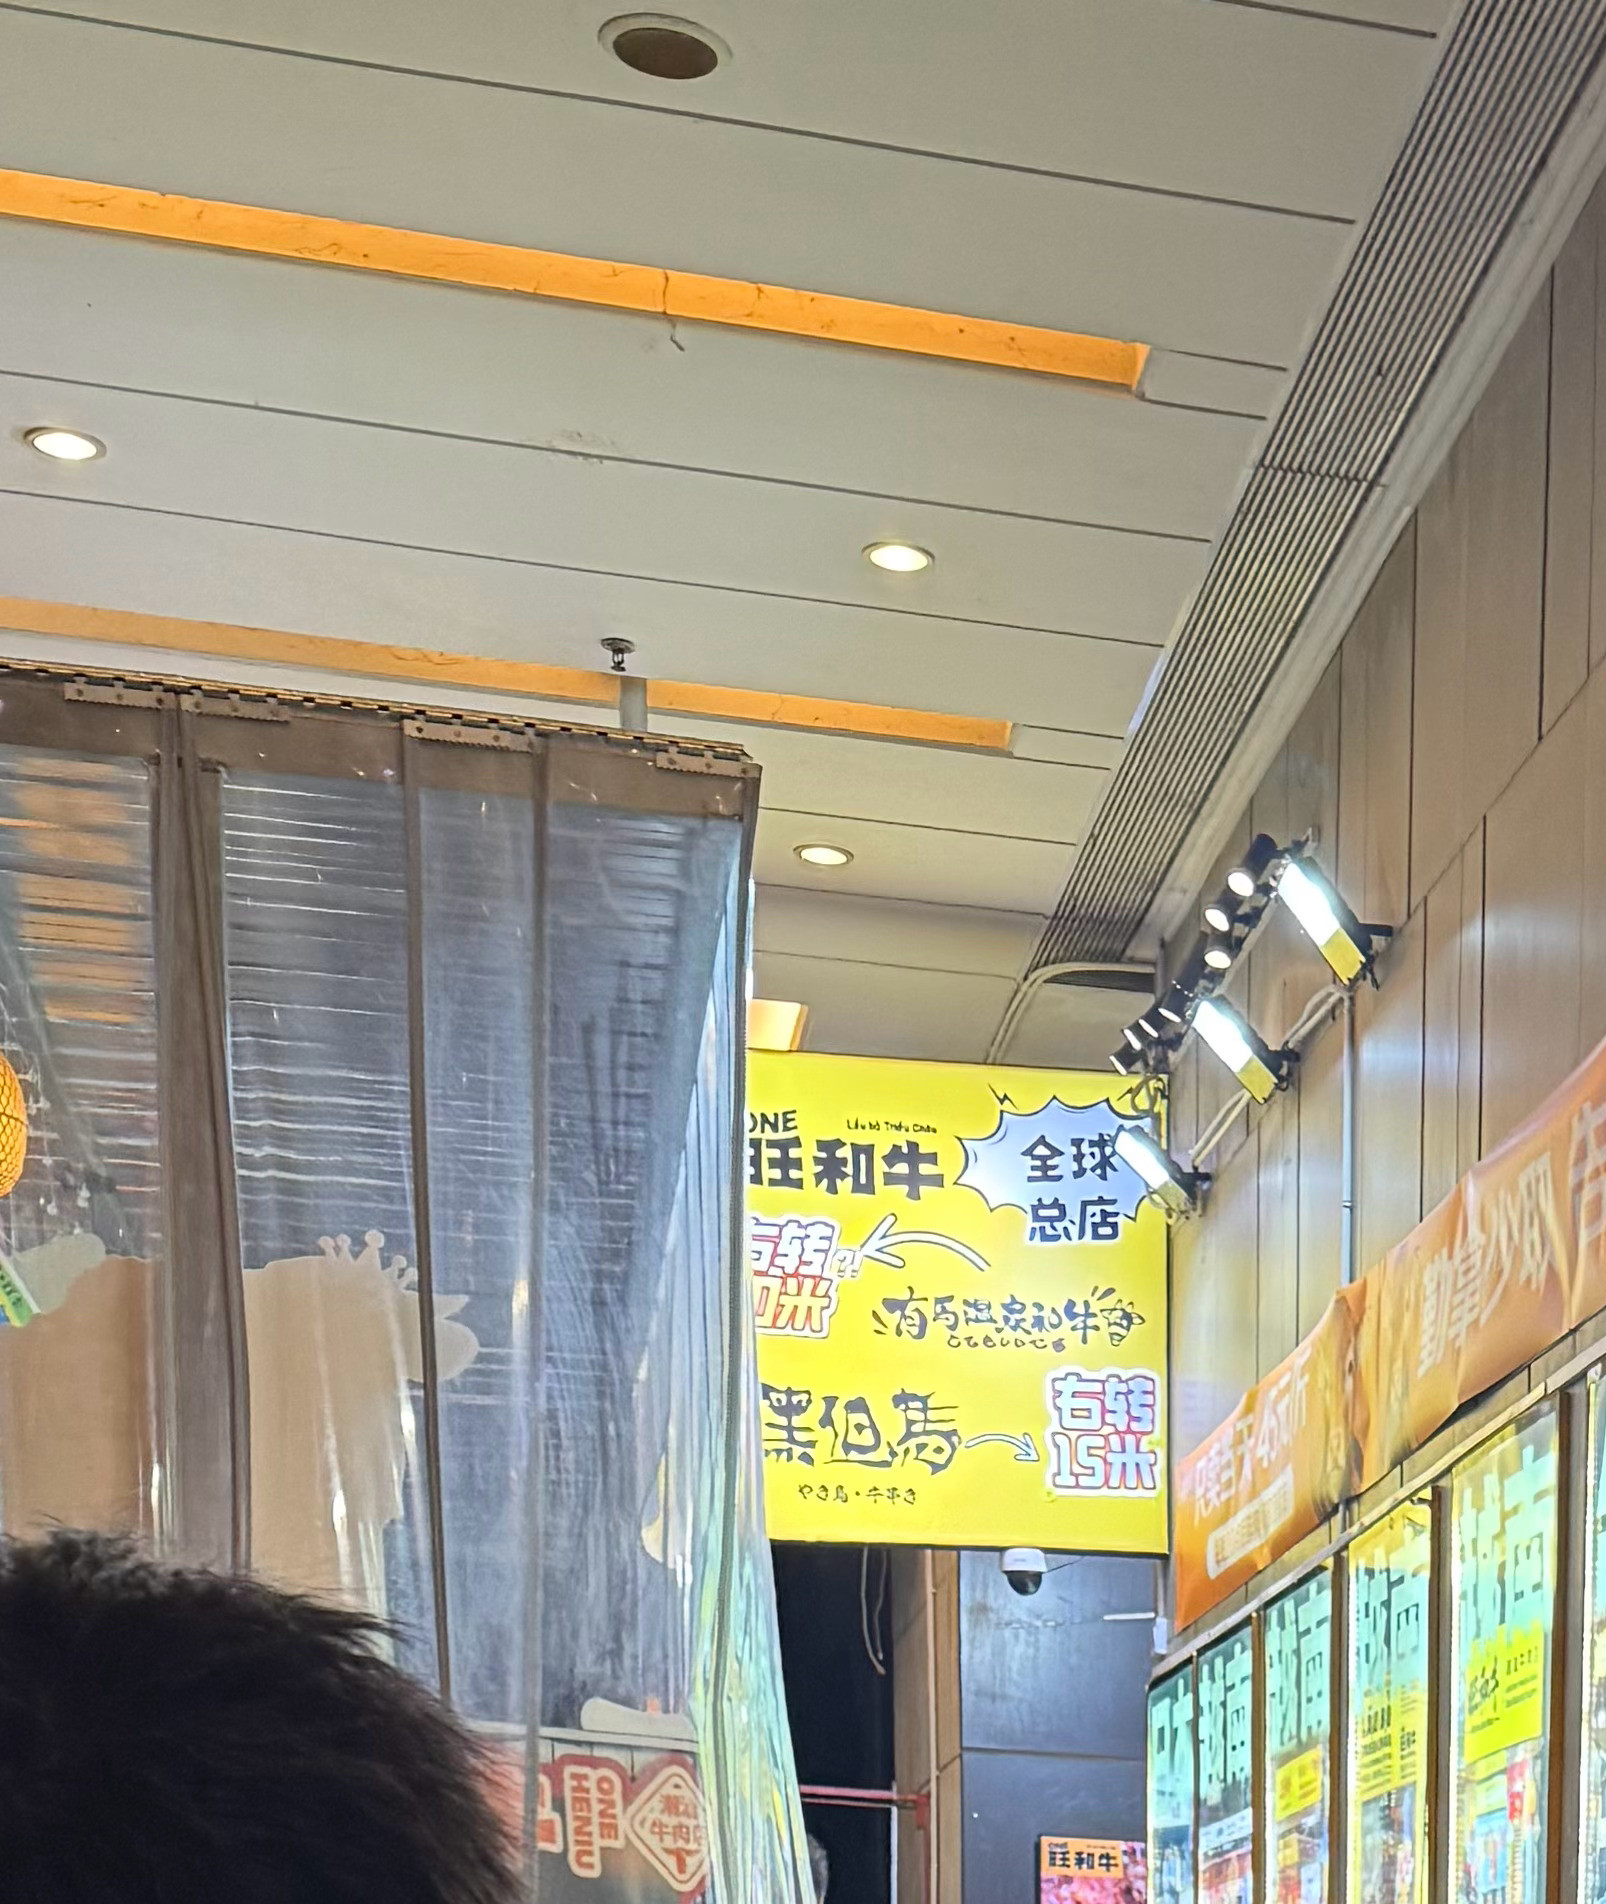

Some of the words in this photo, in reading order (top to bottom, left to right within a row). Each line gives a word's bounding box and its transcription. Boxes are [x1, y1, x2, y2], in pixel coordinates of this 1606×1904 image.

[749, 1135, 944, 1200] 旺和牛
[1021, 1133, 1118, 1182] 全球
[1029, 1196, 1120, 1242] 总店
[752, 1276, 832, 1333] 0米
[882, 1286, 1100, 1345] 有马温泉和牛
[1052, 1372, 1155, 1433] 右转
[1051, 1432, 1157, 1490] 15米
[570, 1772, 594, 1869] HENIU
[596, 1775, 619, 1841] ONE
